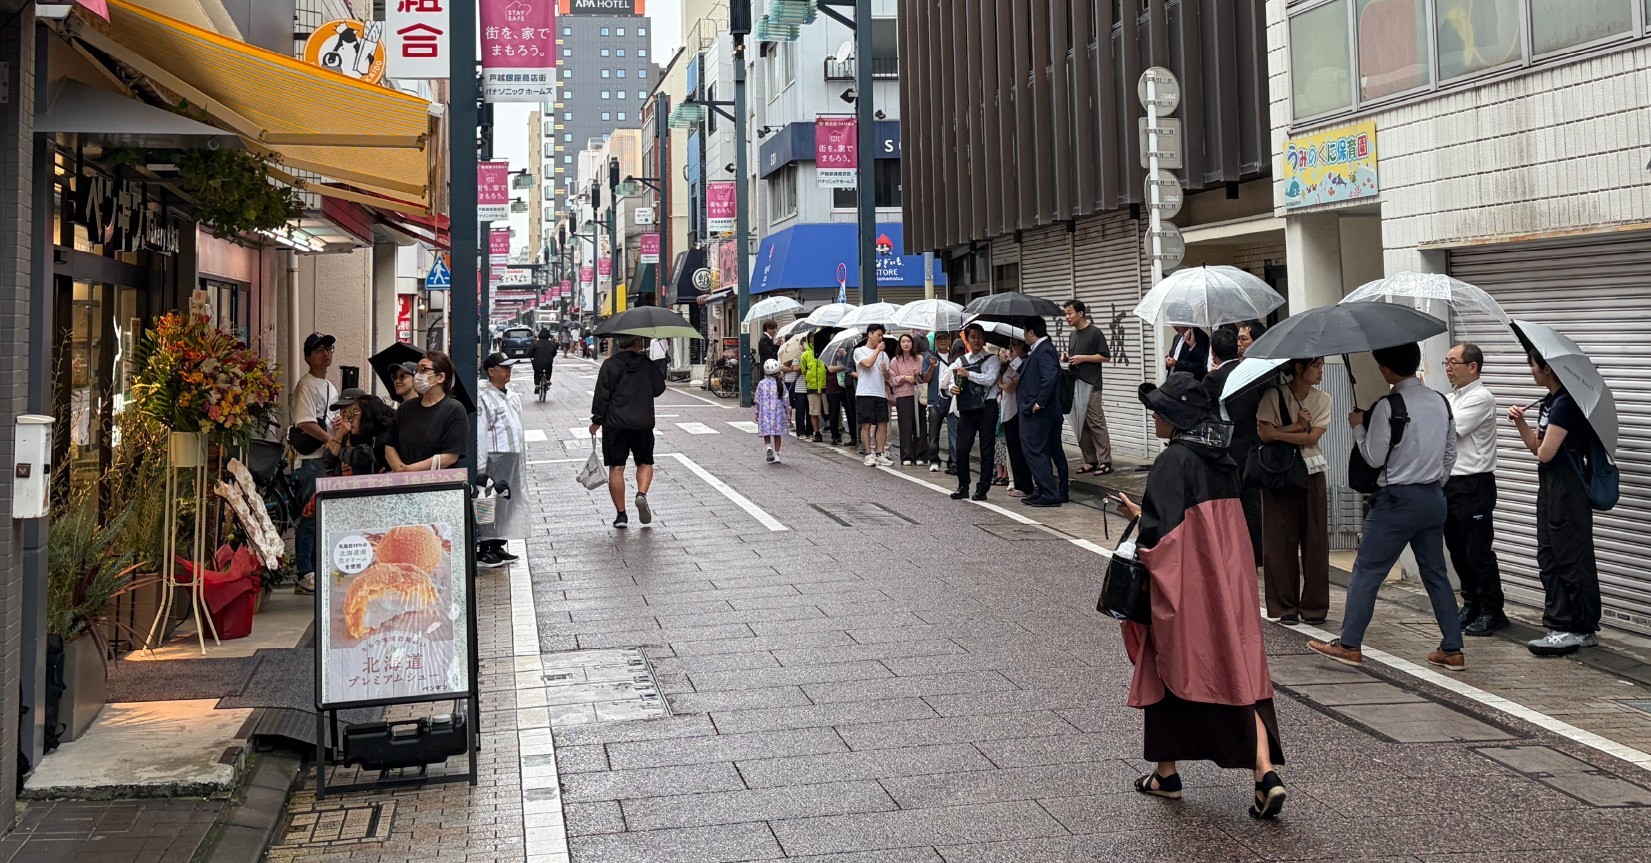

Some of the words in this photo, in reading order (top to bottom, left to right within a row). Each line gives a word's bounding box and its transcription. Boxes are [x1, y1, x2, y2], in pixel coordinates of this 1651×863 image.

[575, 0, 595, 8] APA
[597, 0, 630, 9] HOTEL
[485, 26, 551, 40] 街を、家で
[491, 44, 545, 57] まもろう。
[489, 73, 547, 82] 戸越銀座商店街
[818, 144, 853, 152] 街を、家で
[1287, 133, 1368, 171] うみのくに保育園
[822, 154, 851, 163] まもろう。
[362, 652, 423, 674] 北海道
[348, 673, 440, 688] プレミアムシュー
